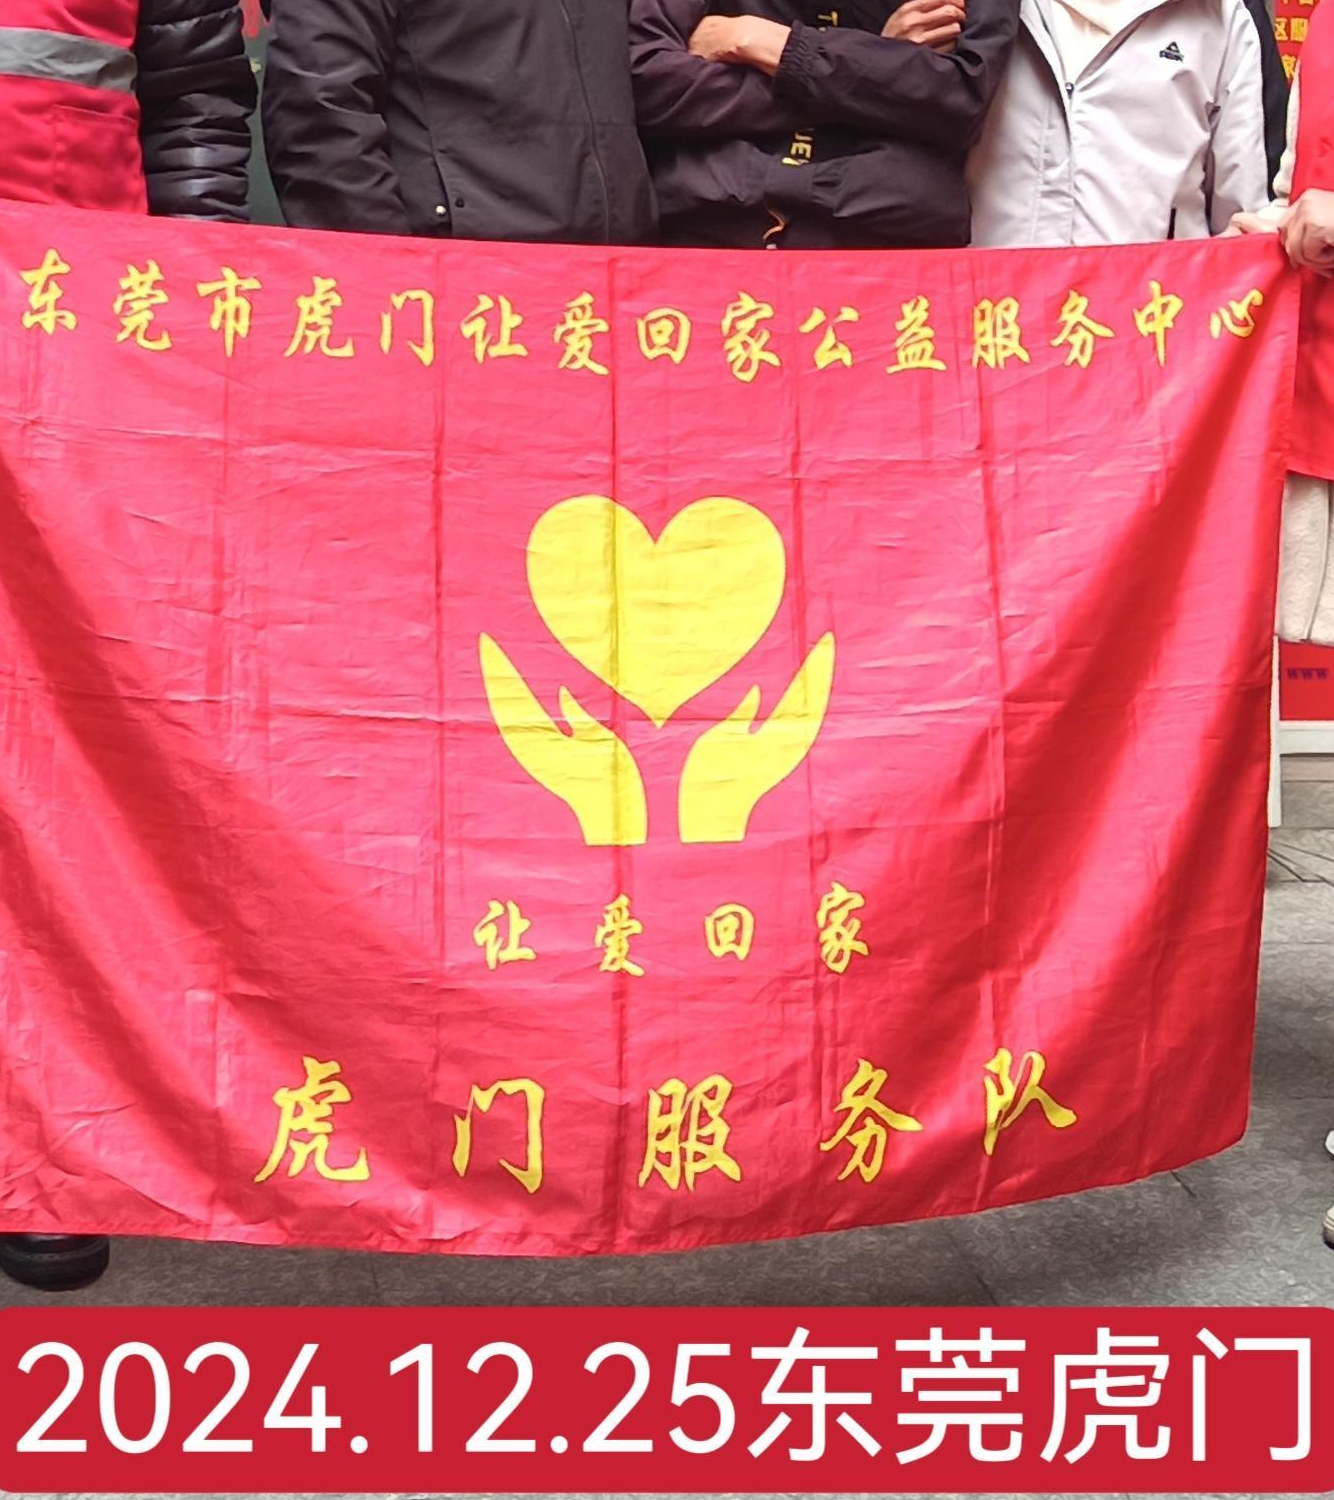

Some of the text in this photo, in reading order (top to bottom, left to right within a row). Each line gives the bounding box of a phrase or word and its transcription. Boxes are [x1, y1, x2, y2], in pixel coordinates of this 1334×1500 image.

[17, 247, 1267, 384] 东莞市虎门让爱回家公益服务中心
[473, 881, 872, 979] 让爱回家
[252, 1047, 1077, 1195] 虎门服务队
